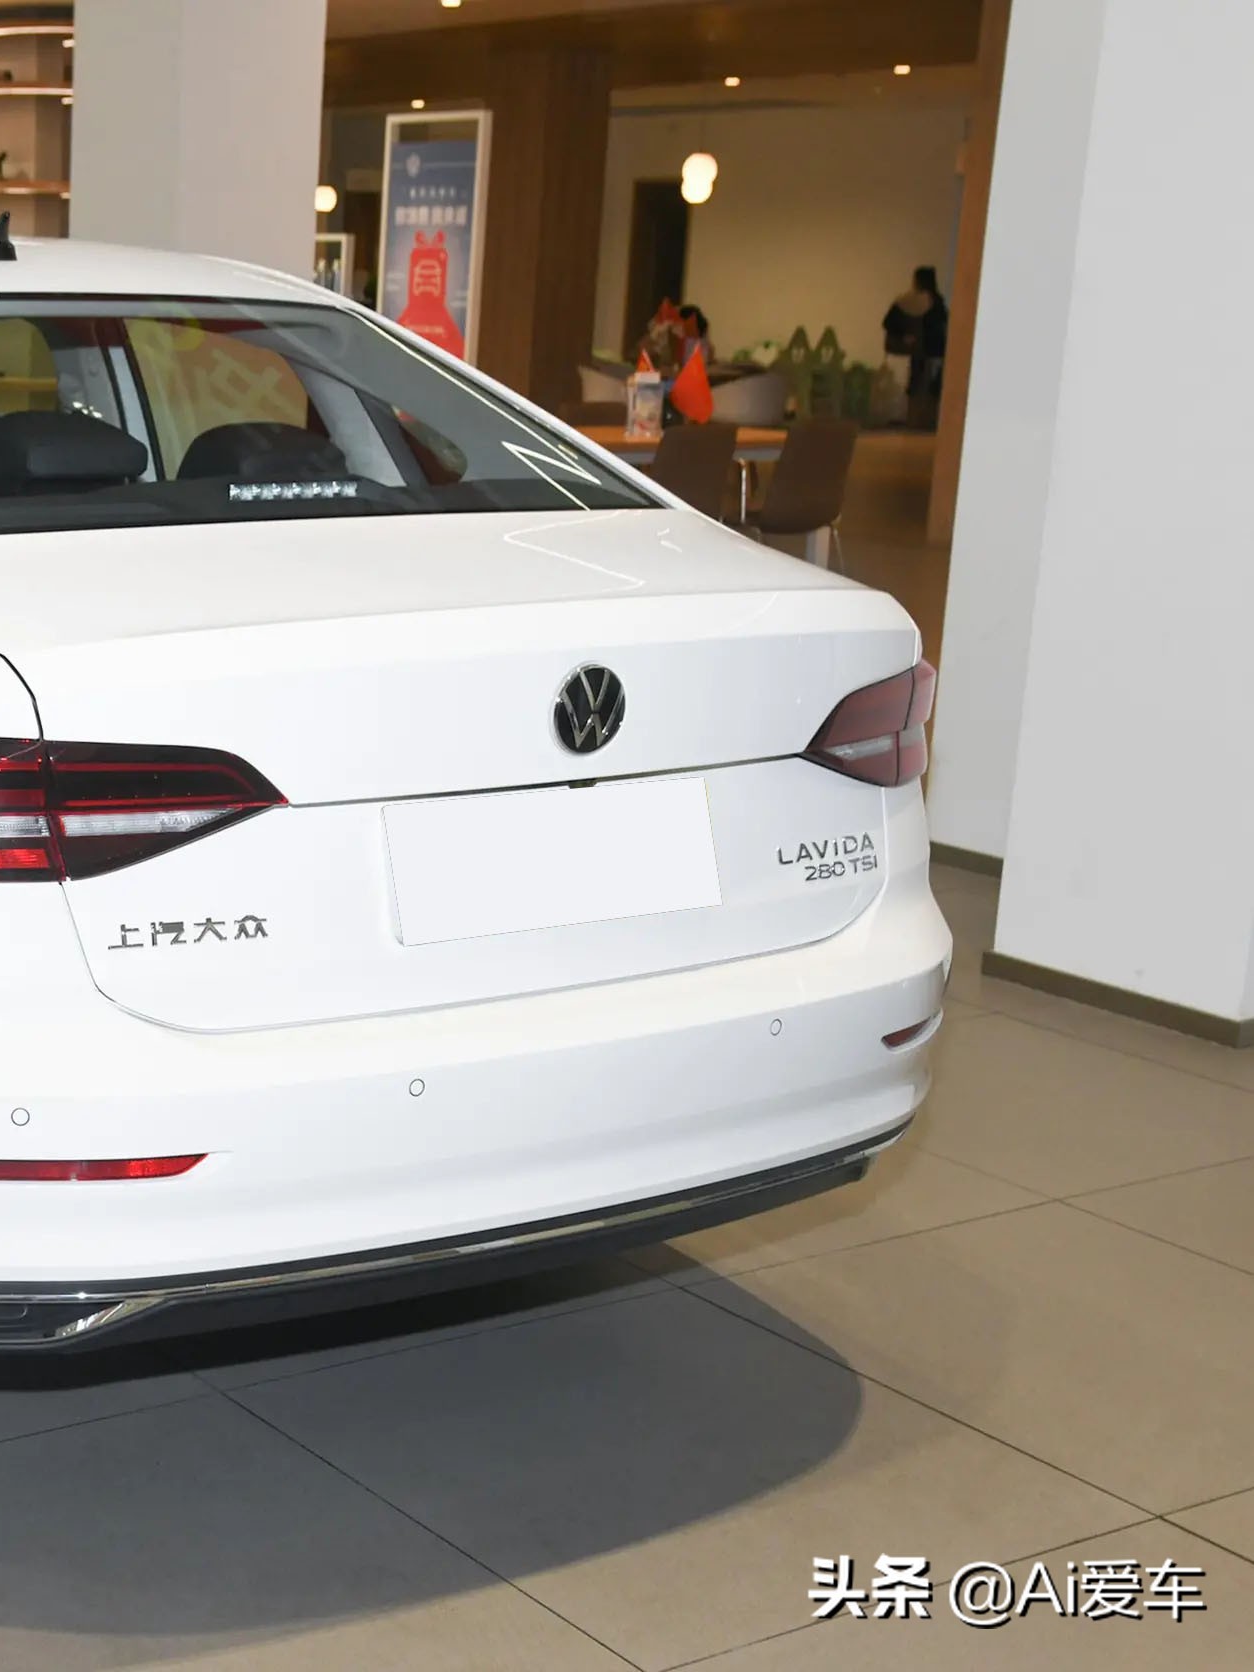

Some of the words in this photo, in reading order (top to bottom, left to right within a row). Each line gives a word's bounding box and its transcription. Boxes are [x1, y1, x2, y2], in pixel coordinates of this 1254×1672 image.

[777, 832, 875, 865] LAVIDA
[805, 861, 845, 881] 280
[848, 855, 878, 874] TSI
[108, 914, 269, 950] 上汽大众
